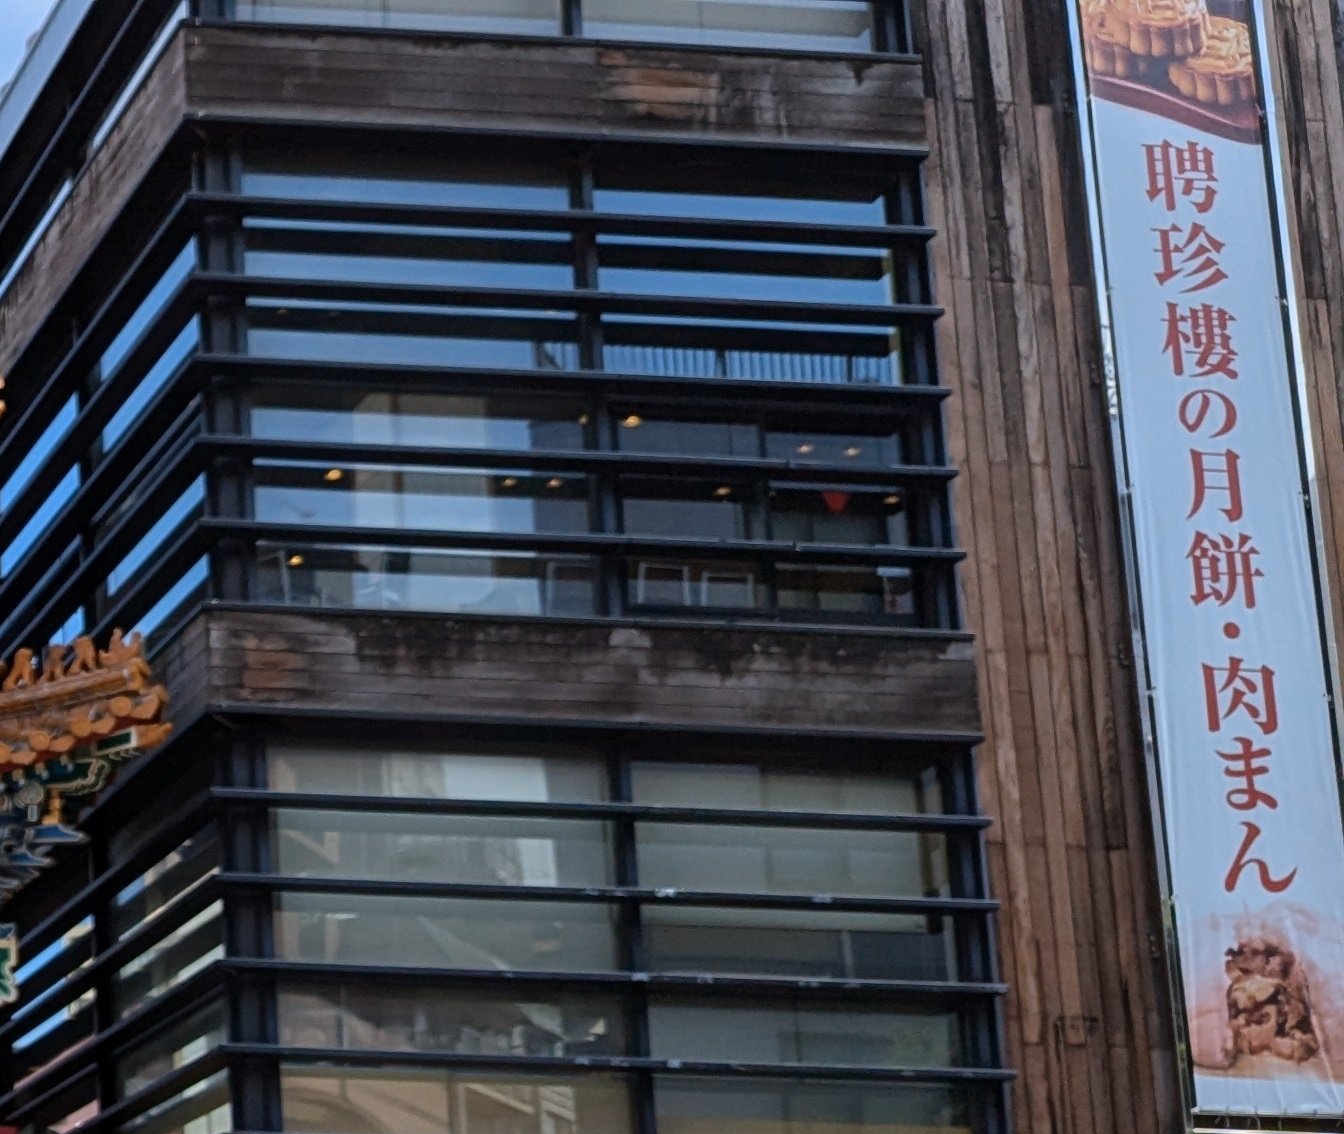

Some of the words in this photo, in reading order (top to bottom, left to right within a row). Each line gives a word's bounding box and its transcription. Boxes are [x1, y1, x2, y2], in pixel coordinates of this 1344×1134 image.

[1140, 139, 1300, 897] 聘珍樓の月餅・肉まん
